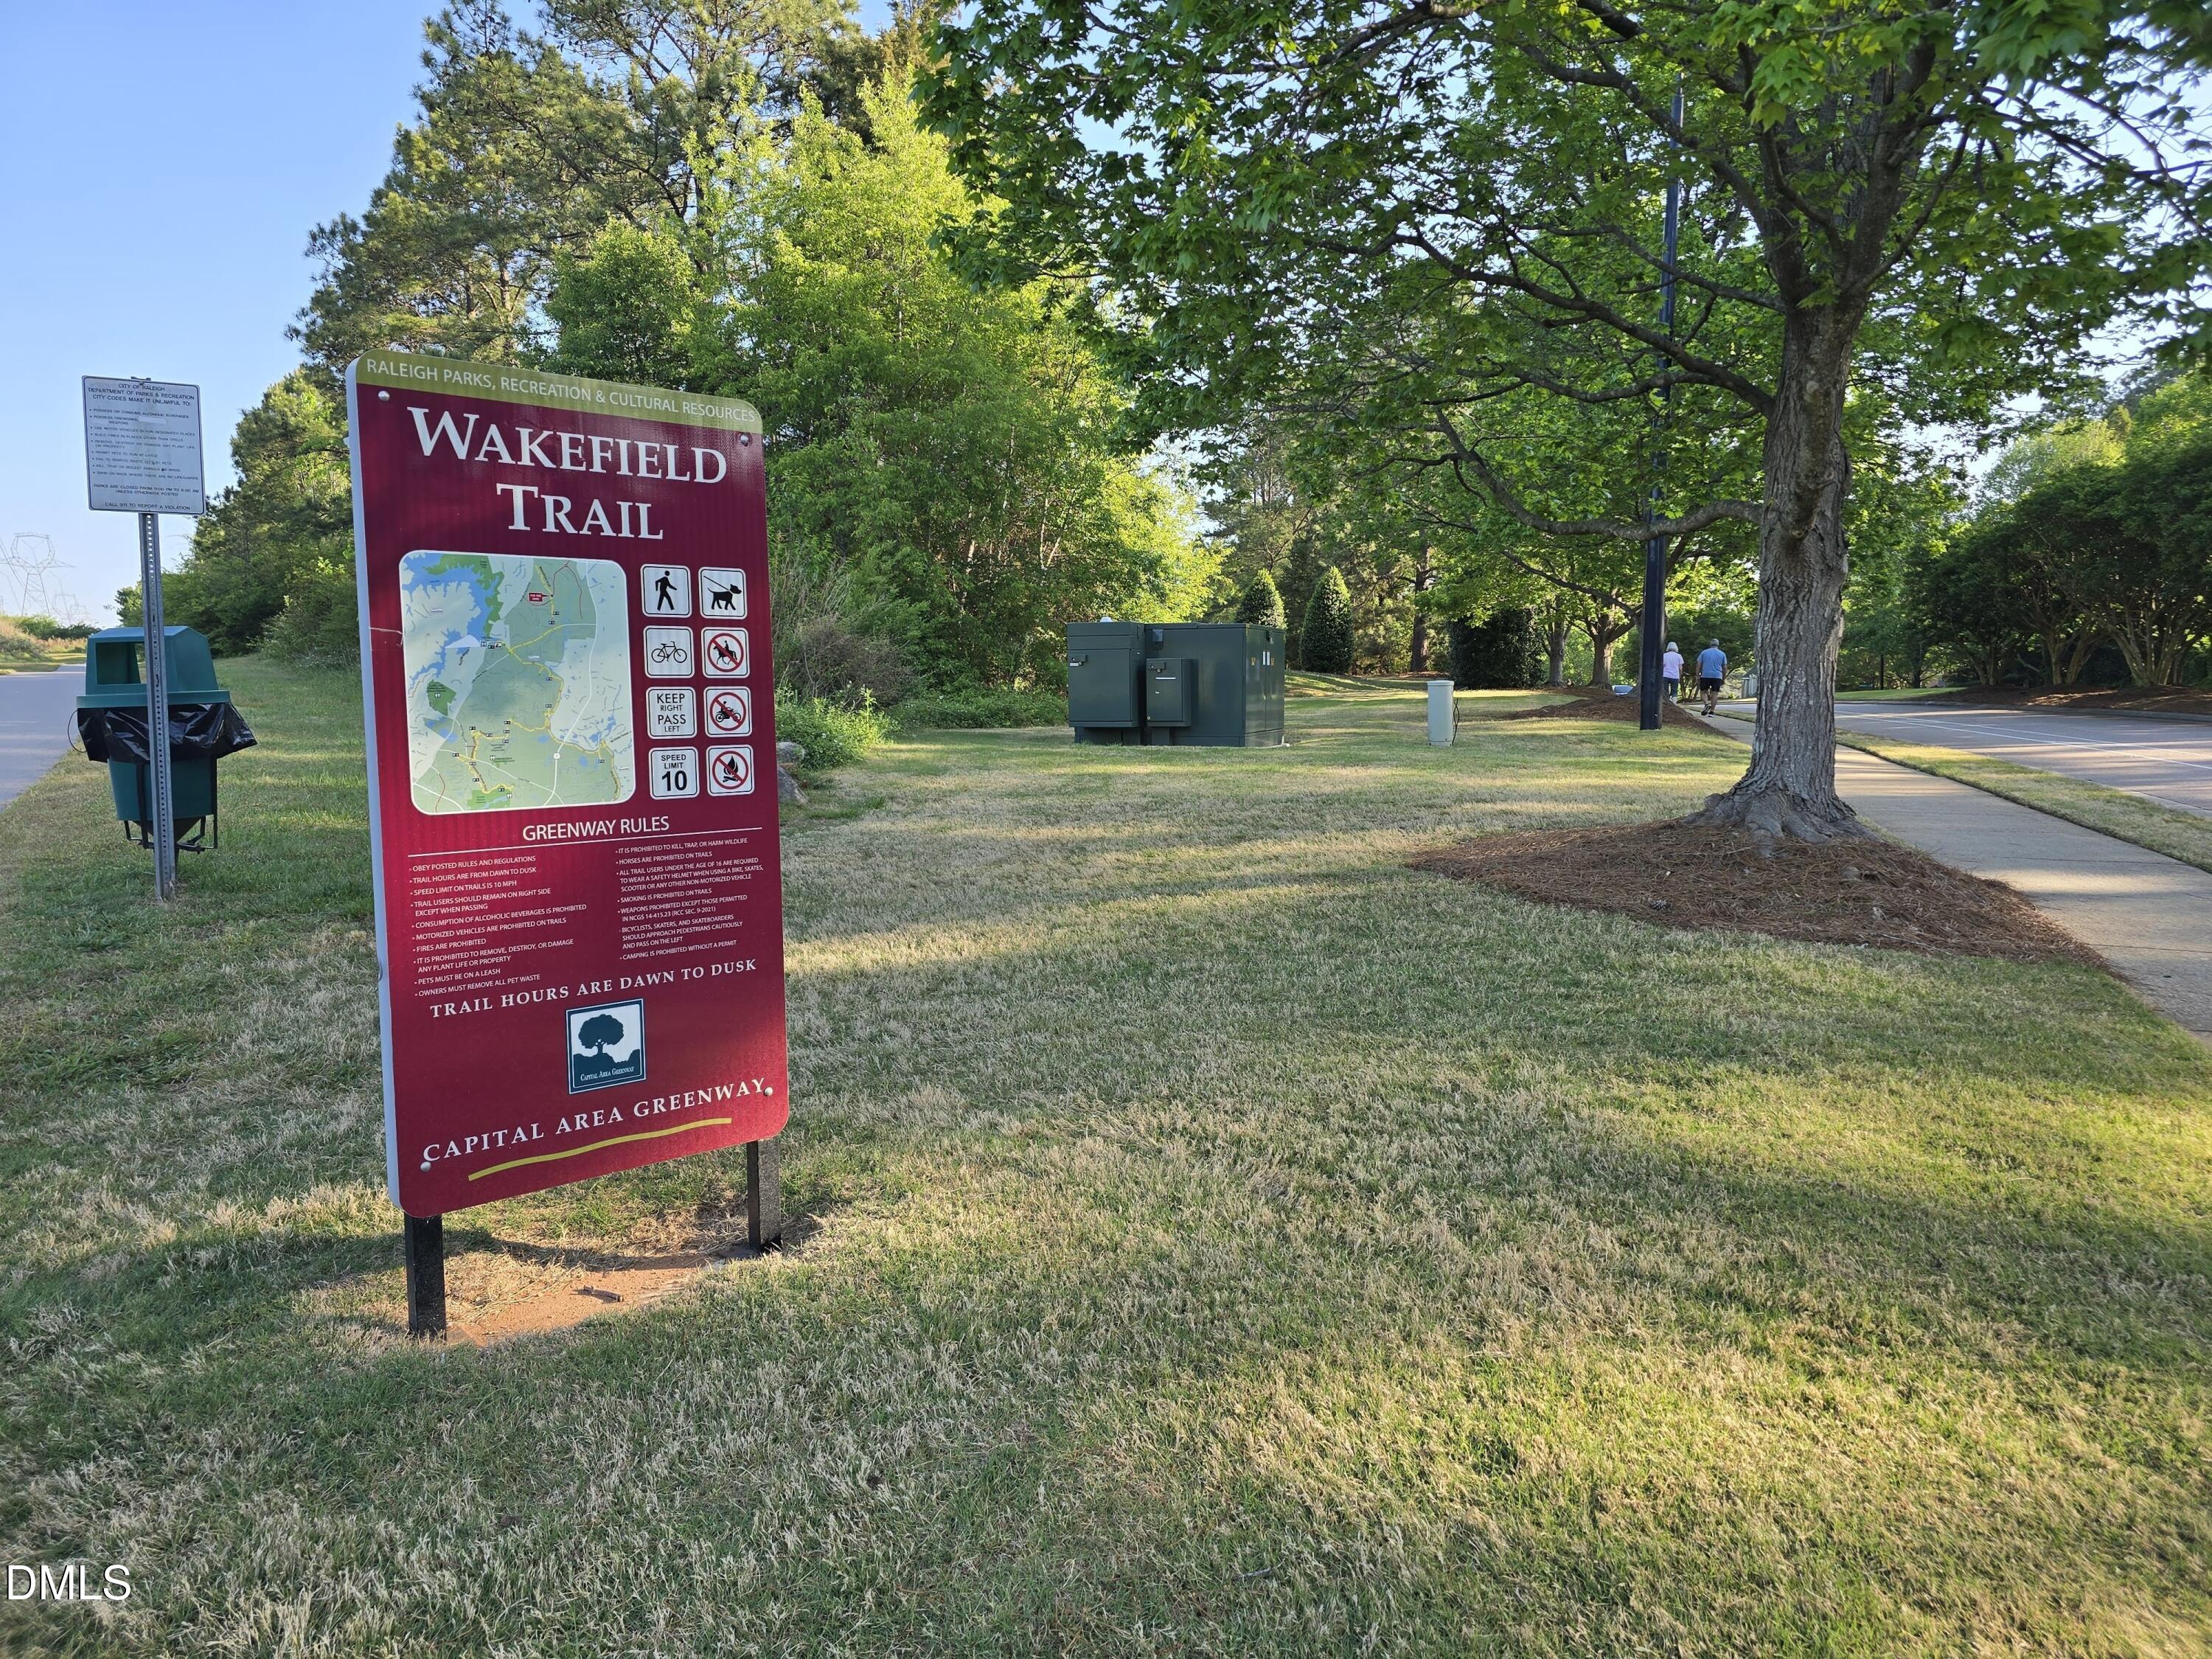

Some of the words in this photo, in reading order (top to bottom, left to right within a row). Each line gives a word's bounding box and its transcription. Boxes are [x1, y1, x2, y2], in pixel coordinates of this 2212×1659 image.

[366, 360, 438, 382] RALEIGH
[501, 377, 591, 401] RECREATION
[596, 389, 606, 403] &
[610, 392, 679, 412] CULTURAL
[683, 401, 755, 422] RESOURCES
[657, 693, 685, 704] KEEP
[658, 714, 686, 724] PASS
[661, 771, 687, 791] 10
[523, 820, 616, 841] GREENWAY
[621, 815, 670, 835] RULES
[412, 864, 430, 872] OBEY
[431, 862, 457, 871] POSTED
[493, 856, 536, 865] REGULATIONS
[619, 857, 641, 865] HORSES
[653, 854, 685, 862] PROHIBITED
[432, 874, 455, 882] HOURS
[519, 866, 537, 874] DUSK
[621, 883, 646, 892] SCOOTER
[668, 880, 686, 888] OTHER
[731, 874, 751, 882] VEHICLE
[414, 888, 434, 896] SPEED
[433, 897, 453, 905] USERS
[454, 894, 481, 903] SHOULD
[482, 892, 507, 901] REMAIN
[518, 889, 536, 897] RIGHT
[621, 894, 647, 903] SMOKING
[653, 891, 684, 900] PROHIBITED
[695, 888, 712, 896] TRAILS
[415, 908, 439, 917] EXCEPT
[440, 906, 460, 914] WHEN
[461, 903, 488, 912] PASSING
[621, 905, 648, 914] WEAPONS
[649, 902, 681, 911] PROHIBITED
[681, 900, 700, 908] EXCEPT
[719, 894, 747, 904] PERMITTED
[415, 917, 464, 928] CONSUMPTION
[475, 912, 510, 922] ALCOHOLIC
[511, 908, 545, 918] BEVERAGES
[552, 904, 587, 914] PROHIBITED
[692, 914, 734, 925] SKATEBOARDERS
[416, 930, 455, 940] MOTORIZED
[456, 927, 485, 936] VEHICLES
[499, 921, 535, 931] PROHIBITED
[547, 917, 566, 926] TRAILS
[622, 933, 646, 942] SHOULD
[646, 929, 675, 939] APPROACH
[676, 925, 711, 935] PEDESTRIANS
[712, 921, 742, 931] CAUTIOUSLY
[431, 952, 469, 962] PROHIBITED
[548, 939, 574, 947] DAMAGE
[448, 938, 486, 948] PROHIBITED
[418, 965, 432, 973] ANY
[433, 962, 453, 971] PLANT
[455, 961, 468, 969] LIFE
[469, 959, 479, 967] OR
[479, 956, 511, 966] PROPERTY
[435, 975, 453, 983] MUST
[481, 968, 501, 977] LEASH
[419, 987, 447, 997] OWNERS
[448, 984, 466, 992] MUST
[467, 981, 493, 990] REMOVE
[495, 978, 506, 987] ALL
[520, 974, 540, 983] WASTE
[431, 997, 493, 1018] TRAIL
[501, 986, 569, 1007] HOURS
[577, 980, 613, 996] ARE
[620, 971, 675, 990] DAWN
[681, 967, 704, 981] TO
[712, 959, 757, 977] DUSK
[423, 1121, 544, 1163] CAPITAL
[555, 1105, 624, 1135] AREA
[634, 1077, 765, 1118] GREENWAY
